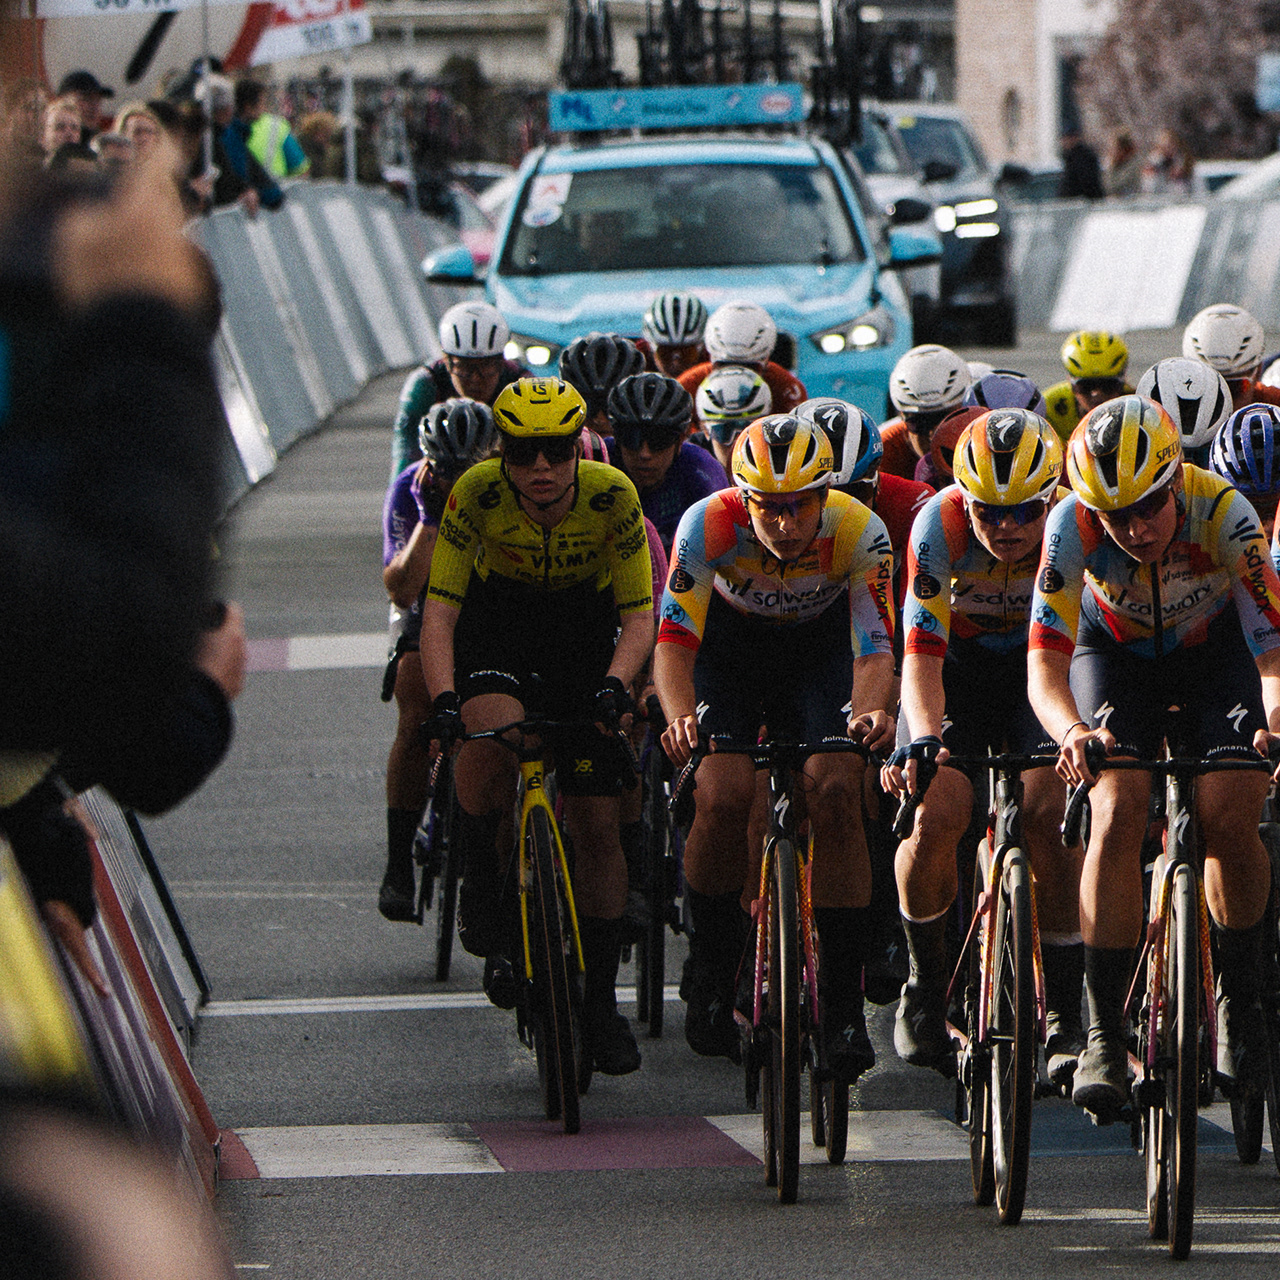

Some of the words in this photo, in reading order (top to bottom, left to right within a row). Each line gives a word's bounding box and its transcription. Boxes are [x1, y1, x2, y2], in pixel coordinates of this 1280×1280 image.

[531, 550, 598, 570] VISMA
[1244, 545, 1272, 616] sdworx
[1207, 745, 1249, 756] dolmans
